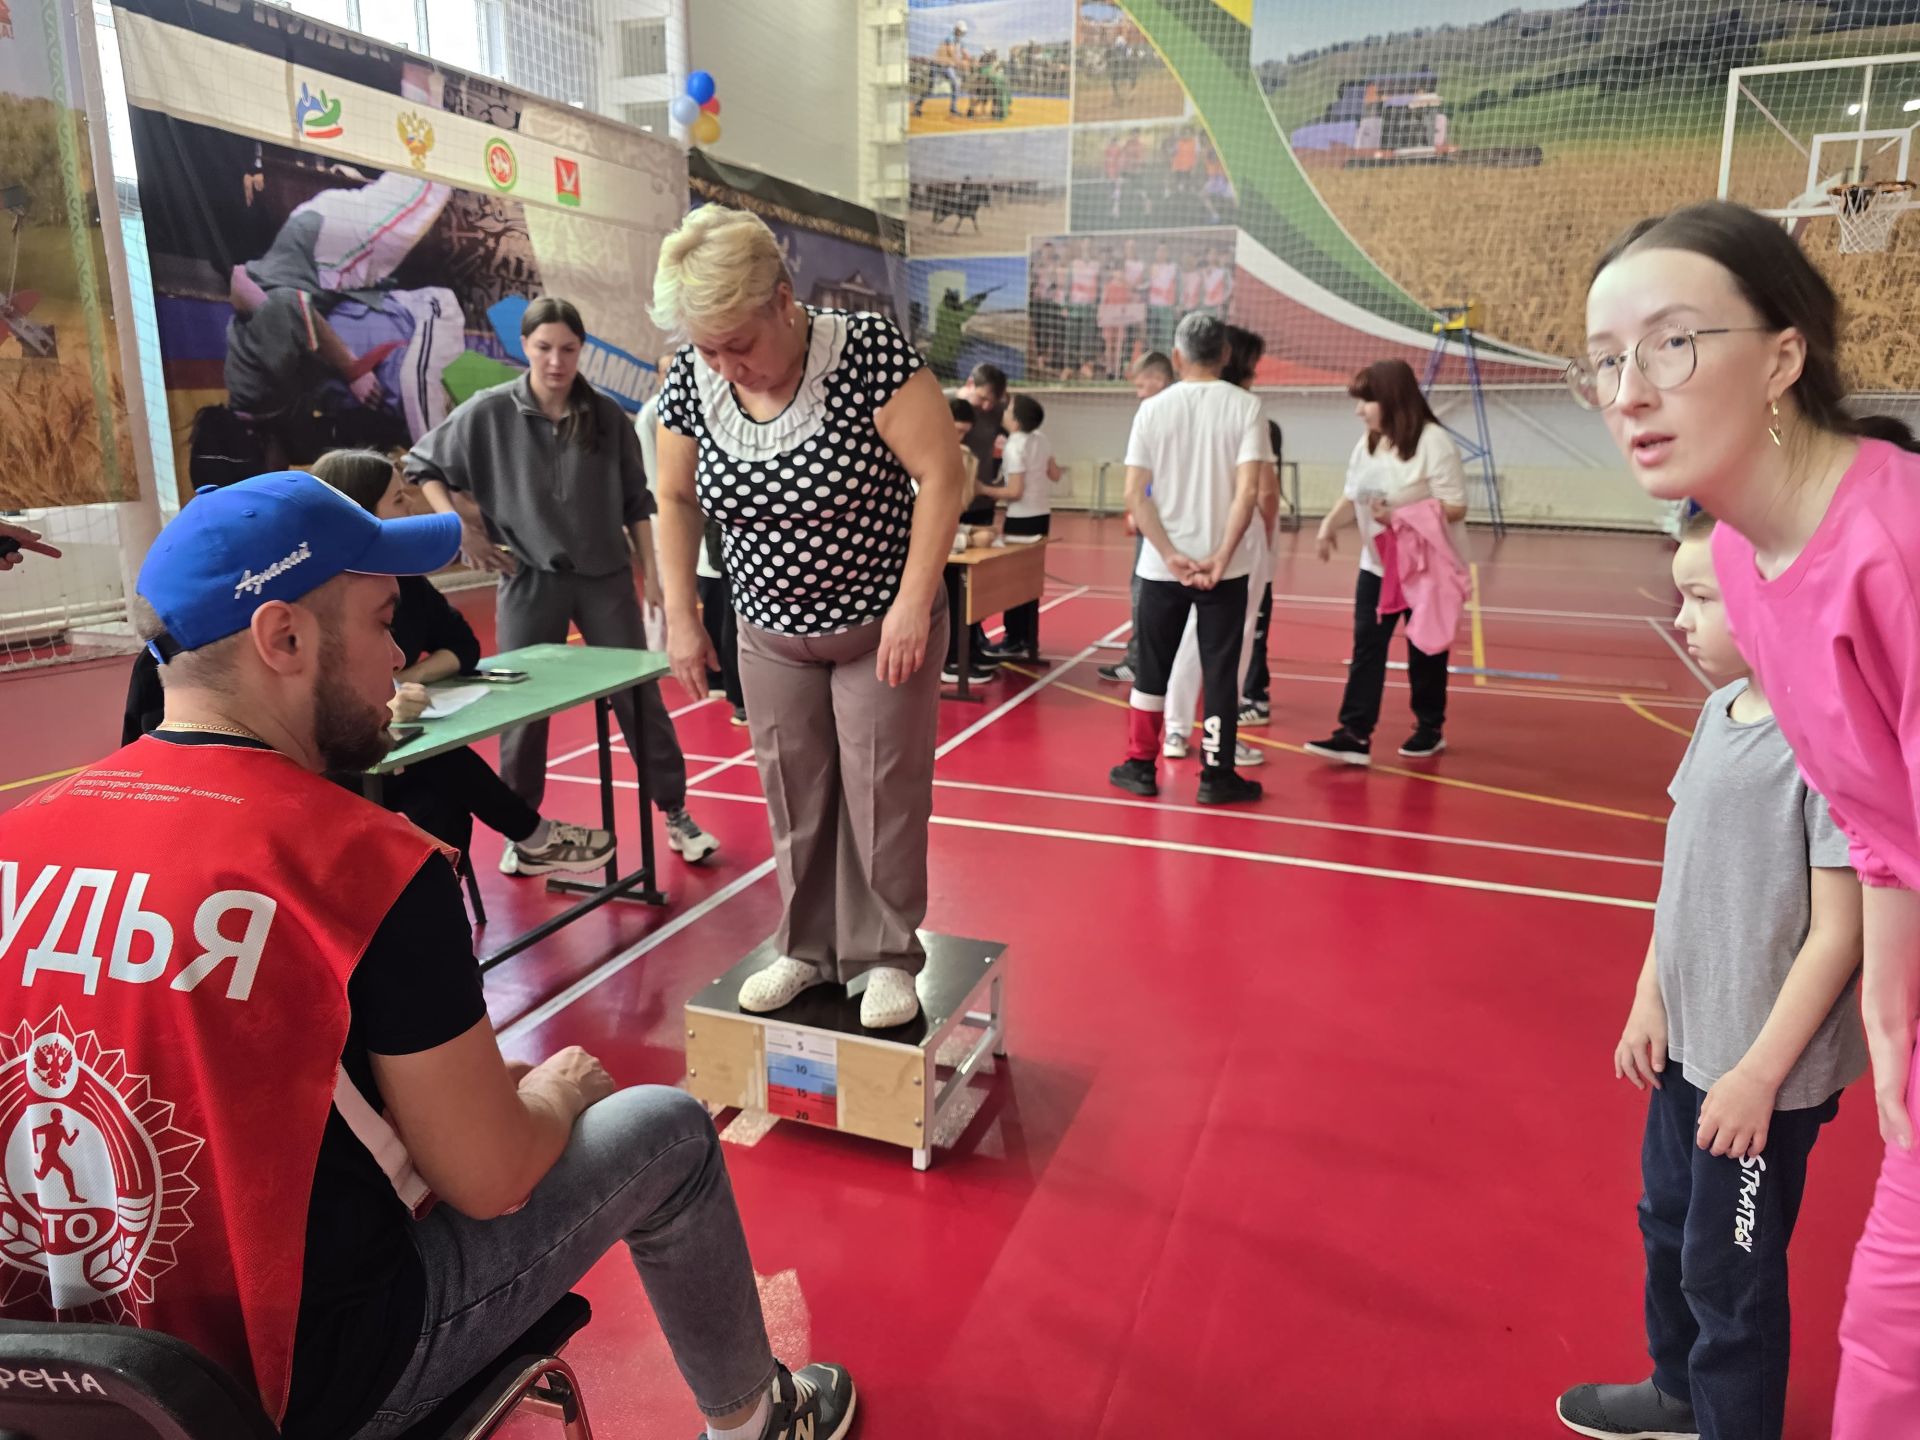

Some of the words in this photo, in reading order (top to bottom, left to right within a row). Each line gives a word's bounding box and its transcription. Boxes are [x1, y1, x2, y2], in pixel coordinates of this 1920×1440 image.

[100, 790, 125, 800] труду
[191, 789, 245, 805] комплекс
[797, 1041, 804, 1051] 5
[795, 1064, 808, 1075] 10
[797, 1088, 808, 1098] 15
[795, 1110, 809, 1121] 20
[1734, 1154, 1767, 1253] STRATEGY
